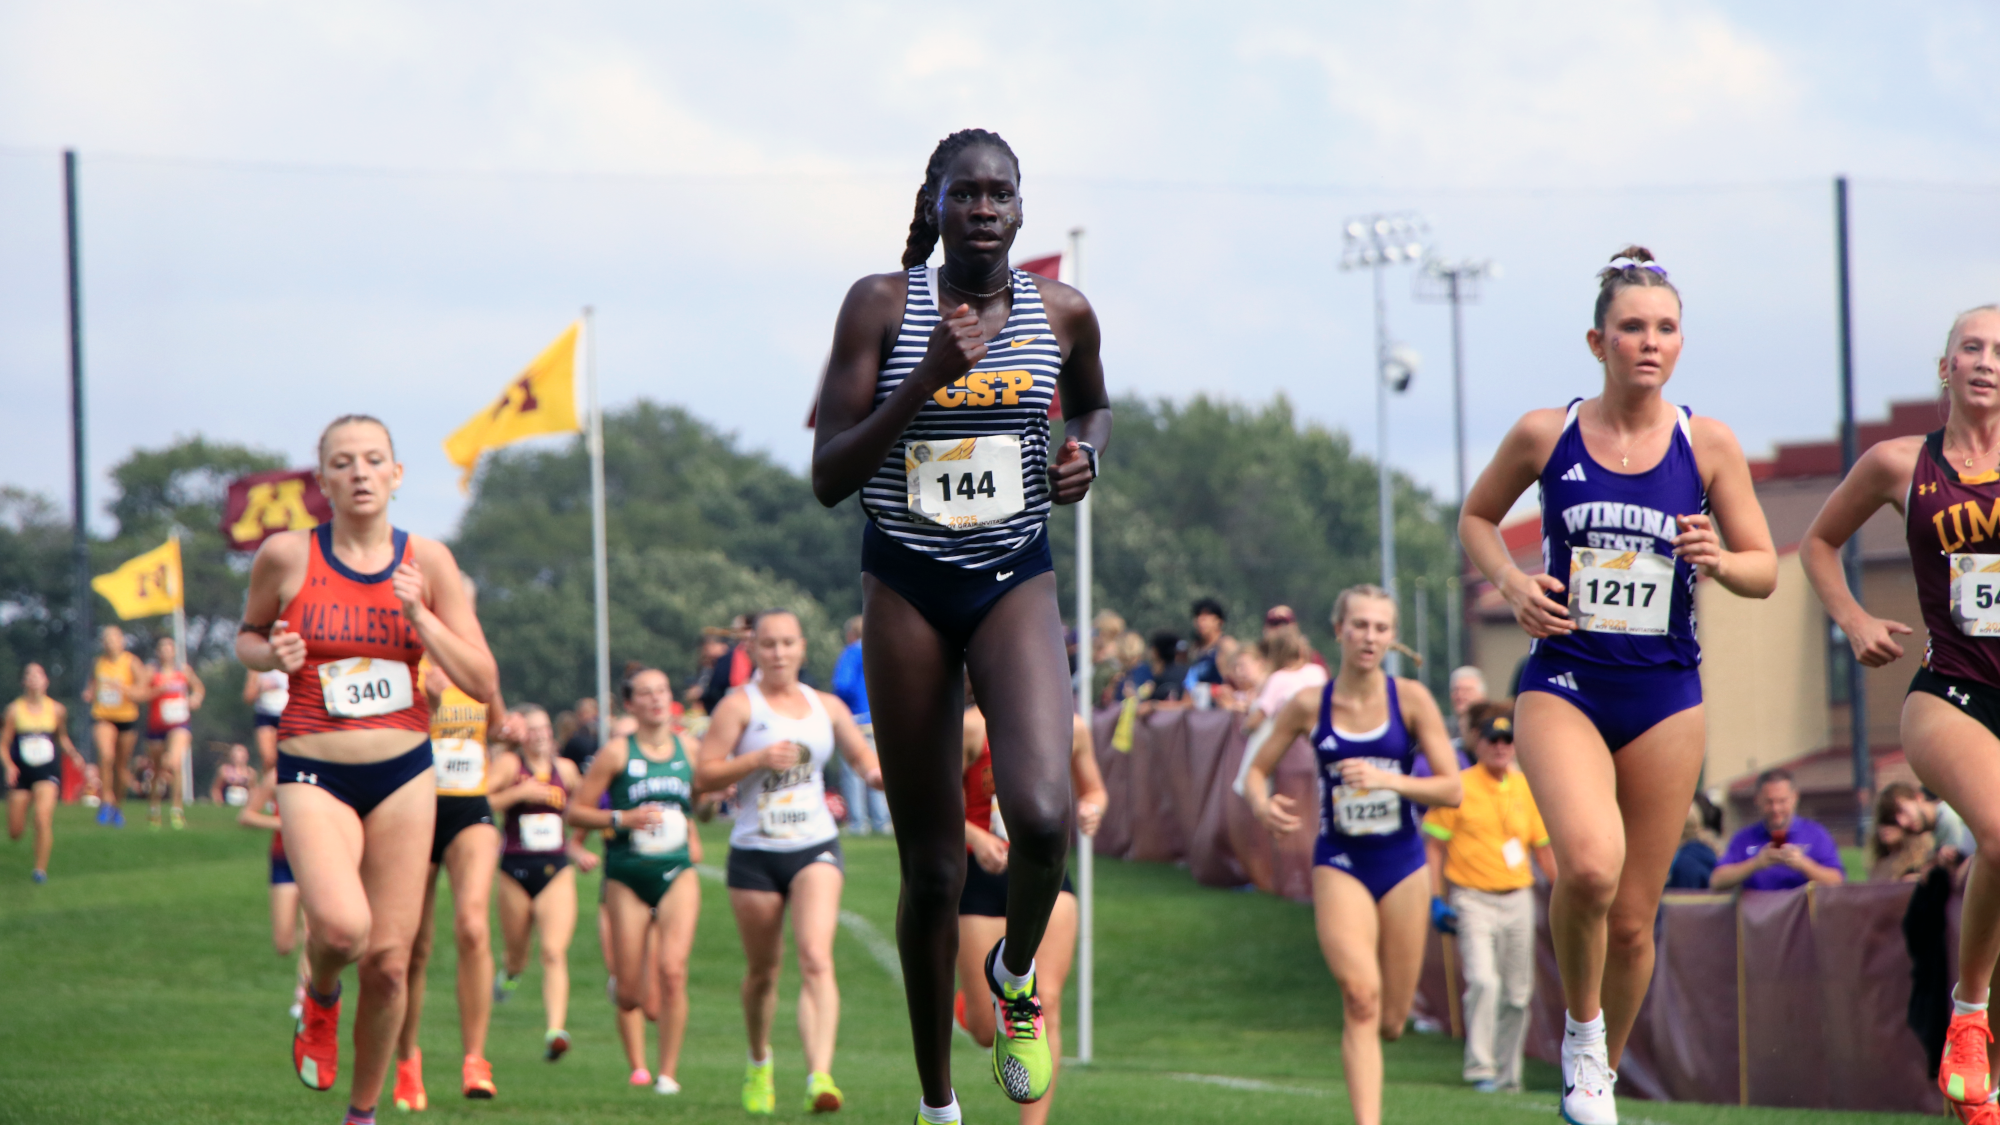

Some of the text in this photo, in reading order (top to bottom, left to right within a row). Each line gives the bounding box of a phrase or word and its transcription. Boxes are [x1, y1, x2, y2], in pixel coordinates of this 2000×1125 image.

[932, 370, 1034, 408] CSP
[936, 470, 996, 502] 144
[231, 478, 319, 543] M
[949, 515, 978, 526] 2025
[1562, 501, 1677, 543] WINONA
[1587, 531, 1655, 554] STATE
[1587, 579, 1657, 608] 1217
[301, 603, 421, 649] MACALESTE
[1601, 618, 1628, 628] 2025
[346, 679, 391, 704] 340
[1345, 802, 1387, 820] 1225
